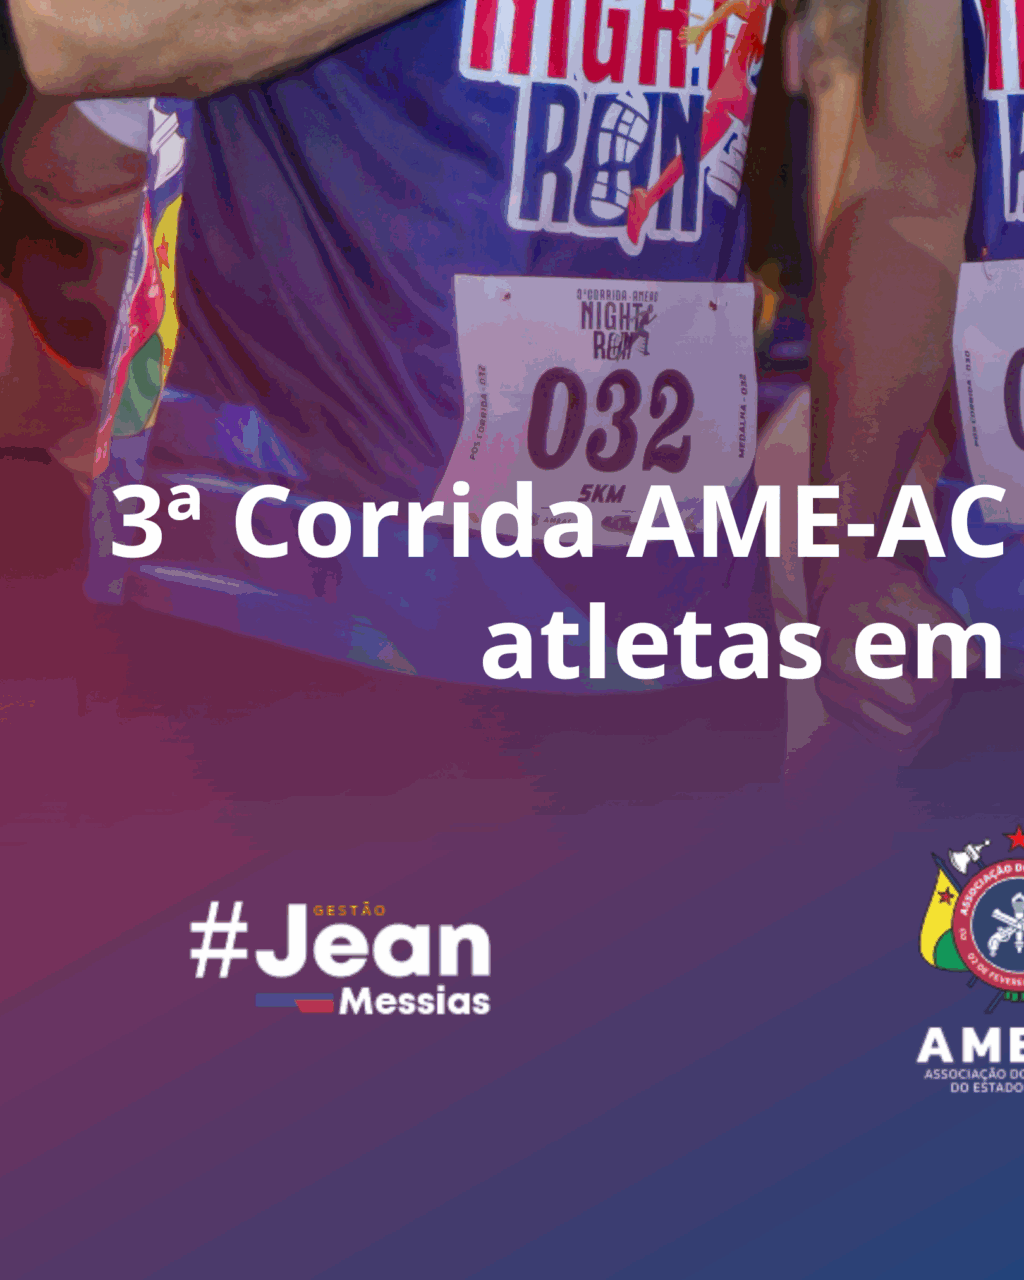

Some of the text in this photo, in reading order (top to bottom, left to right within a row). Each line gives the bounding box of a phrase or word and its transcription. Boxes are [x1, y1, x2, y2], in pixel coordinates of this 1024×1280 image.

[518, 81, 705, 233] RUN
[581, 301, 643, 331] NIGHT
[593, 330, 632, 361] RUN
[527, 366, 695, 474] 032
[577, 483, 627, 504] 5KM
